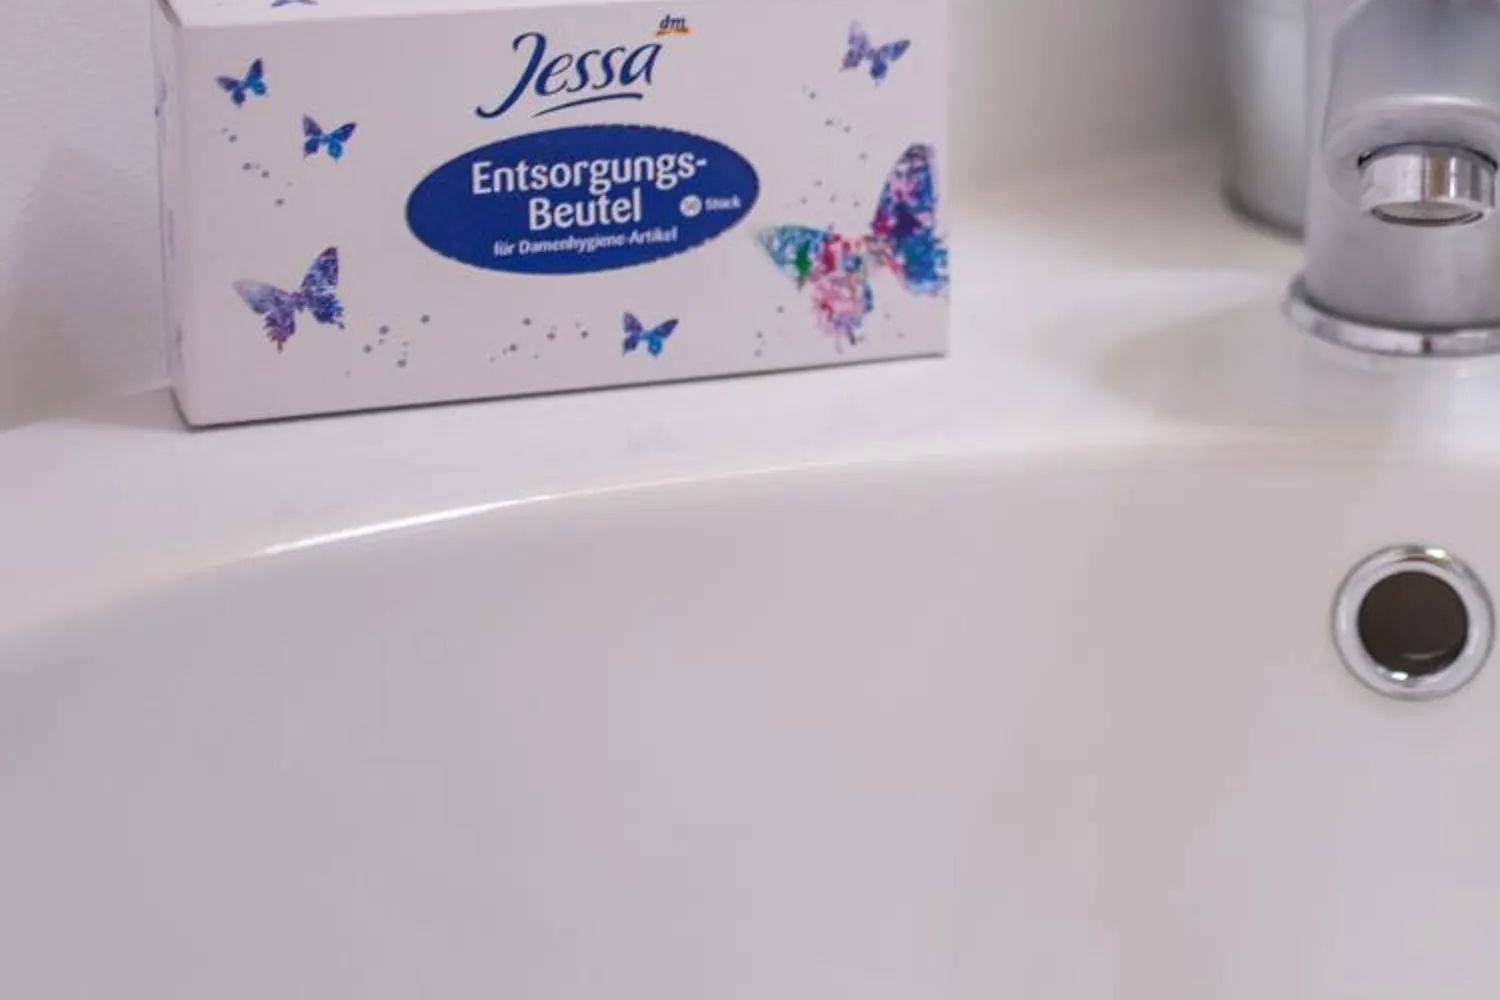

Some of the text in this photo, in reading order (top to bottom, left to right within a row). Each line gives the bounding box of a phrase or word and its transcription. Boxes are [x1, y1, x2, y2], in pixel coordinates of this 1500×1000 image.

[659, 13, 686, 30] dm
[475, 31, 664, 119] Jessa
[471, 151, 707, 195] Entsorgungs-
[528, 188, 641, 232] Beutel
[493, 226, 678, 257] für Damenhygiene-Artikel
